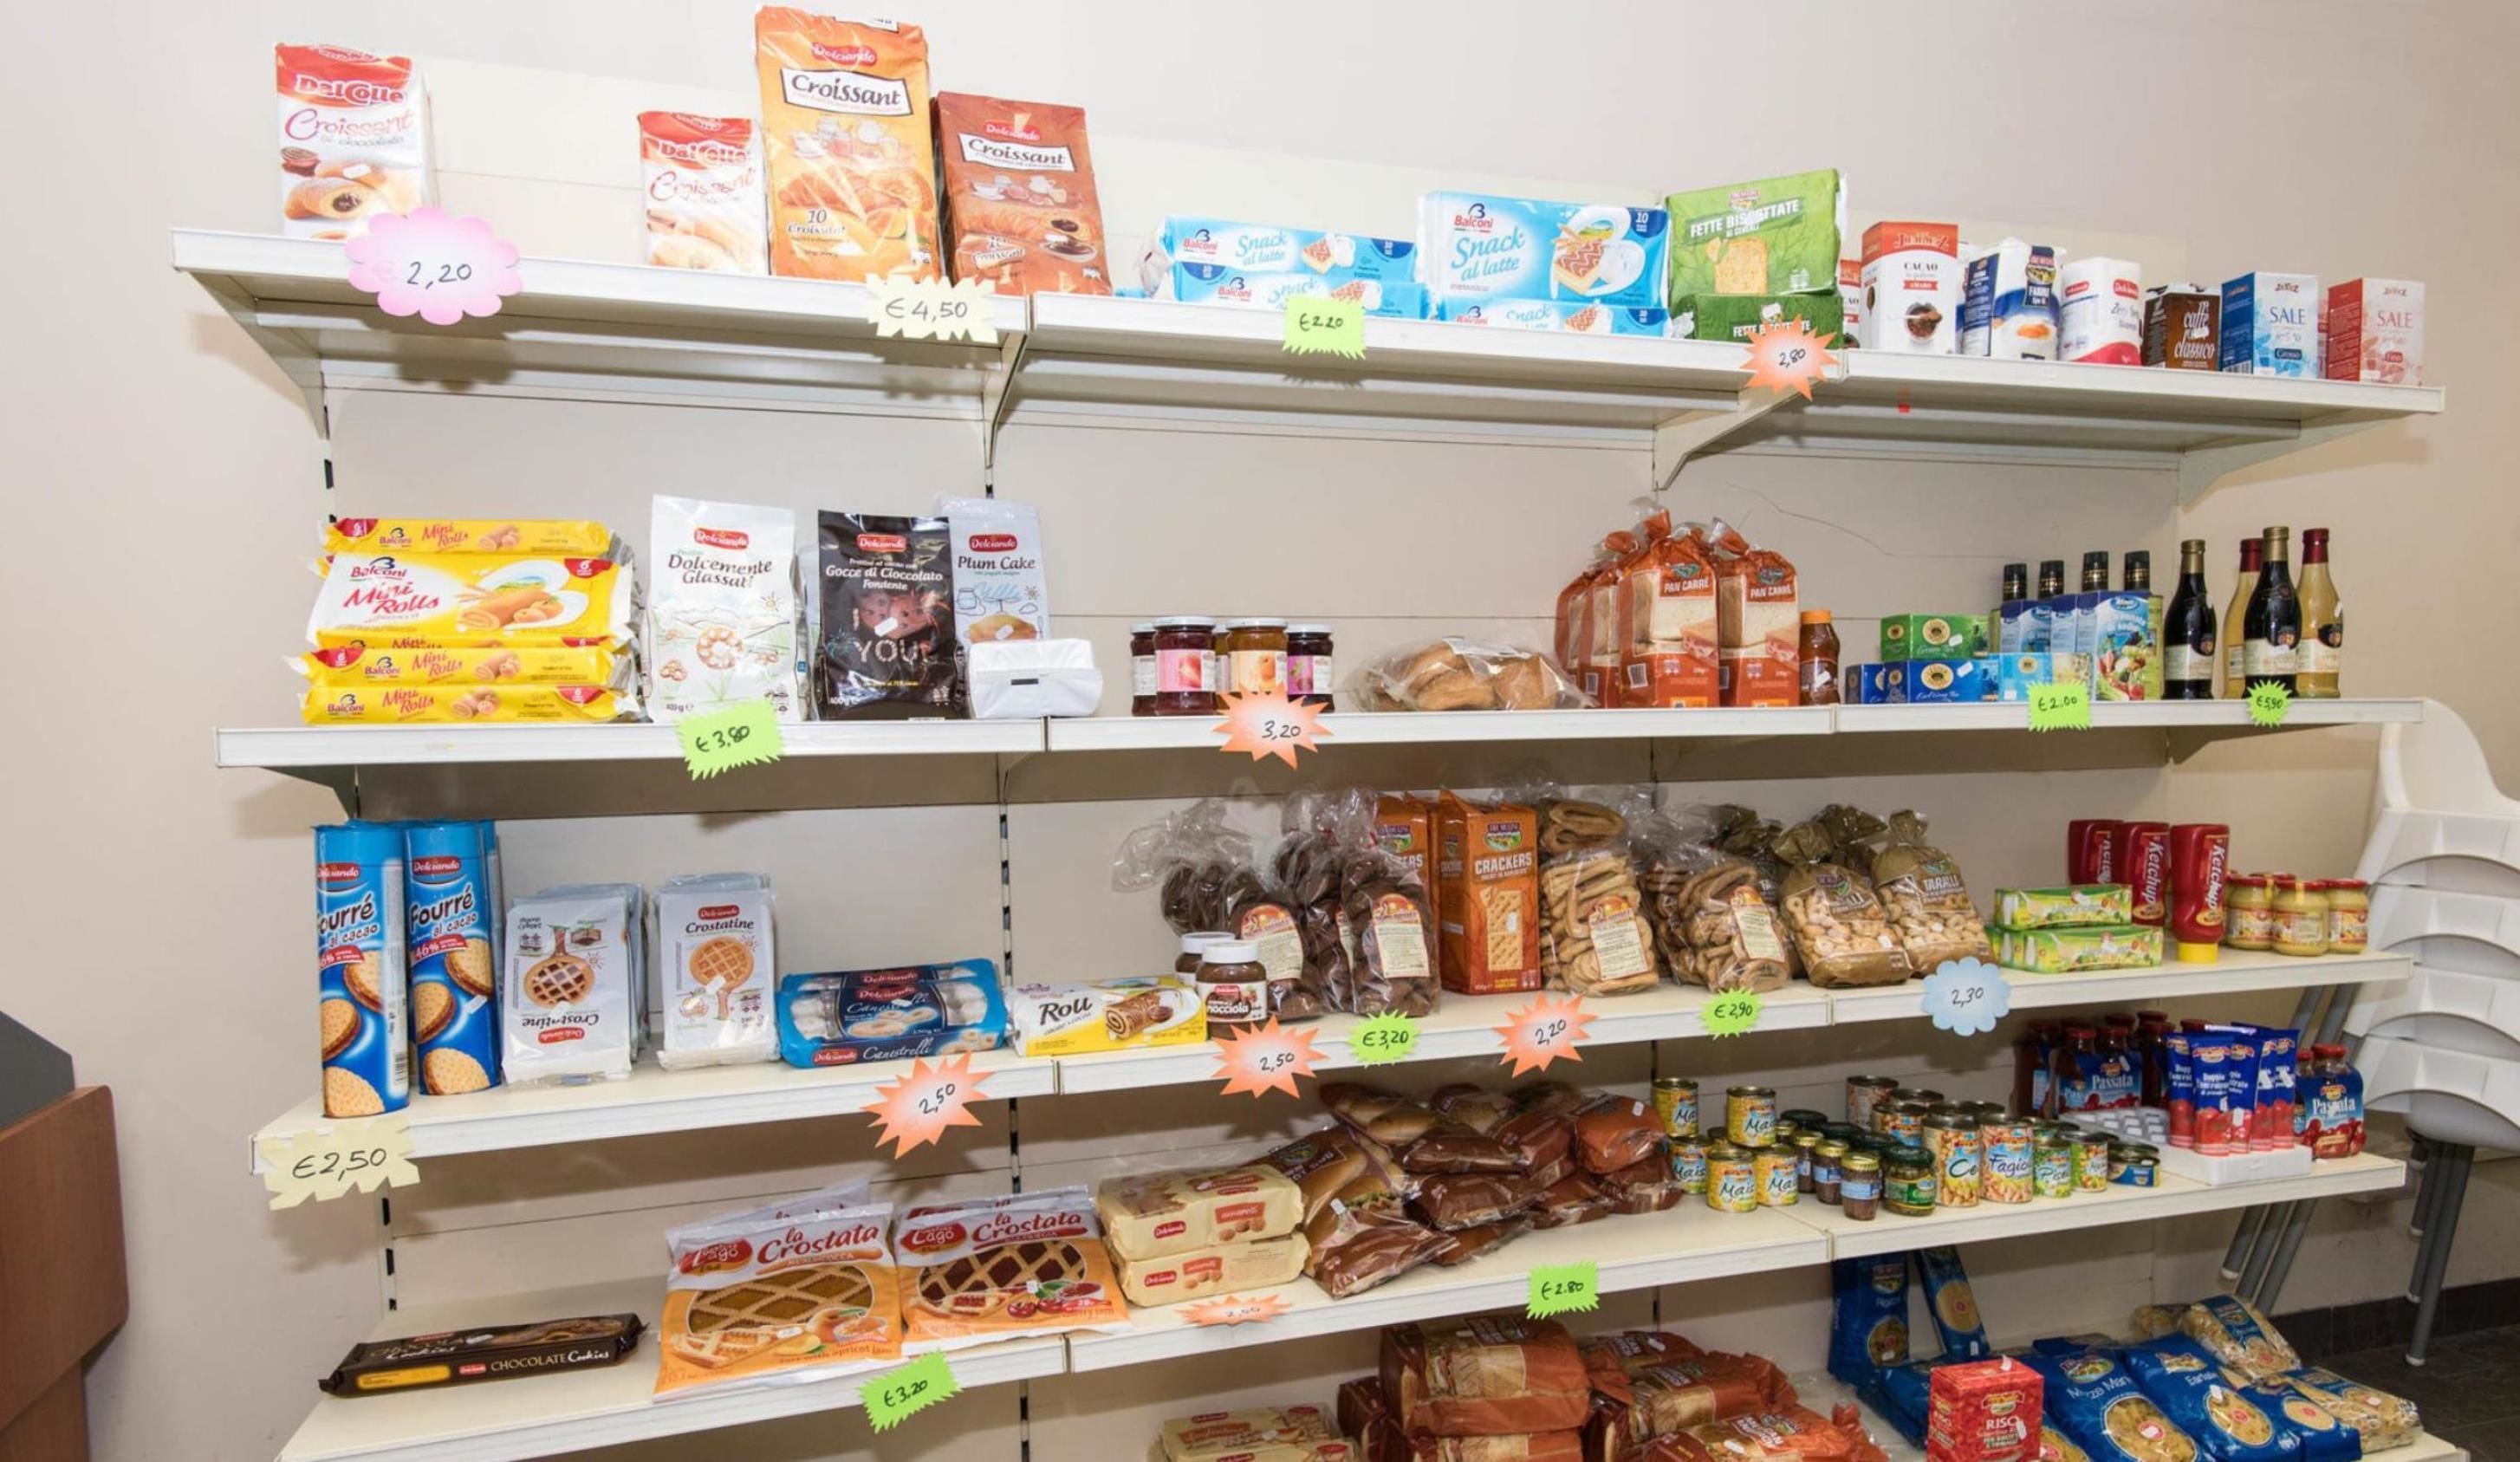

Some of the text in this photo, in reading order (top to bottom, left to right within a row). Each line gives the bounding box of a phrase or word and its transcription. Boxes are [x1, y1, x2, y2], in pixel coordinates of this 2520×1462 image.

[791, 74, 901, 106] Croissant
[285, 108, 414, 140] Croissant
[968, 138, 1066, 165] Croissant
[1453, 214, 1494, 229] Balconi
[1635, 211, 1649, 224] 10
[1691, 218, 1724, 239] FETTE
[1183, 237, 1218, 251] Balconi
[1235, 229, 1288, 258] Snack
[1451, 226, 1525, 270] Snack
[406, 261, 473, 289] 2,20
[1482, 257, 1521, 278] latte
[1904, 262, 1939, 271] CACAO
[1218, 286, 1252, 299] Balconi
[2269, 305, 2307, 325] SALE
[2376, 309, 2413, 329] SALE
[1779, 348, 1806, 368] 2,80
[379, 536, 412, 546] Balconi
[421, 524, 455, 542] Mini
[438, 531, 469, 547] Rolls
[971, 538, 1016, 549] Dolciando
[350, 563, 408, 579] Balconi
[580, 559, 589, 569] 6
[668, 553, 773, 575] Dolcemente
[958, 556, 1036, 570] Plum Cake
[682, 569, 754, 589] Glassati
[825, 564, 944, 582] Gocce di Cioccolato
[862, 579, 908, 591] Fondente
[1664, 582, 1680, 593] PAN
[1750, 588, 1767, 598] PAN
[343, 582, 414, 608] Mini
[377, 593, 440, 614] Rolls
[412, 650, 448, 671] Mini
[854, 640, 919, 666] YOU
[364, 666, 400, 677] Balconi
[432, 660, 464, 678] Rolls
[382, 688, 419, 708] Mini
[399, 695, 435, 712] Rolls
[327, 703, 365, 714] Balconi
[1262, 720, 1301, 741] 3,20
[413, 859, 460, 872] Dolciando
[1474, 851, 1533, 875] CRACKERS
[2141, 841, 2166, 906] Ketchup
[446, 913, 477, 932] cacao
[685, 919, 755, 933] Crostatine
[341, 924, 379, 942] cacao
[1951, 988, 1984, 1005] 2,30
[1039, 998, 1093, 1025] Roll
[1535, 1018, 1567, 1045] 2,20
[862, 1037, 935, 1060] Canestrelli
[1259, 1051, 1296, 1072] 2,50
[2091, 1074, 2134, 1090] Passata
[919, 1083, 956, 1114] 2,50
[1719, 1181, 1756, 1200] Mais
[971, 1212, 1082, 1243] Crostata
[995, 1213, 1011, 1227] la
[757, 1224, 880, 1264] Crostata
[784, 1226, 805, 1244] la
[911, 1230, 954, 1245] Lago
[490, 1349, 610, 1372] CHOCOLATE Cookies
[1985, 1415, 2020, 1431] RISO
